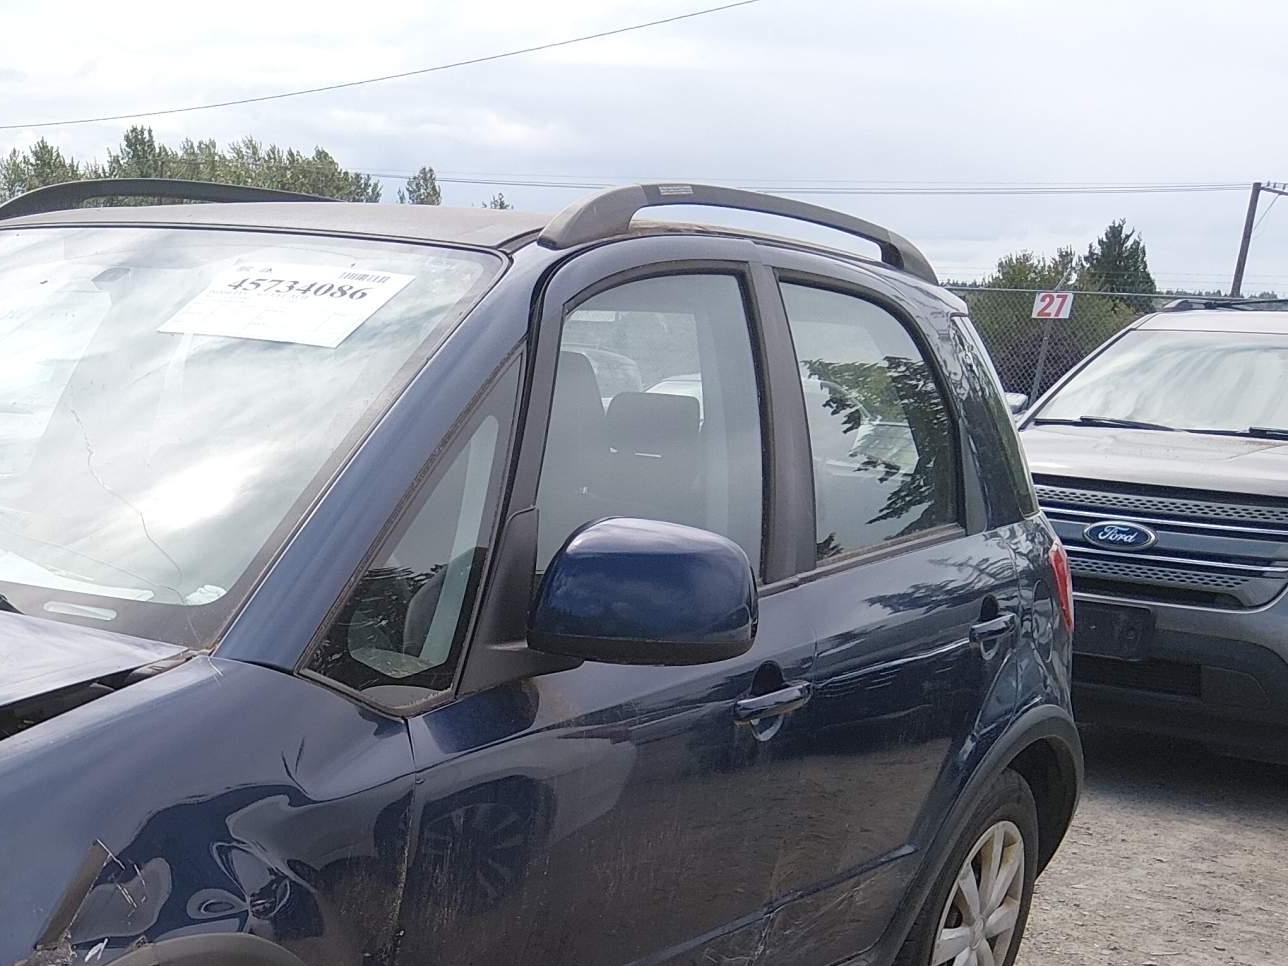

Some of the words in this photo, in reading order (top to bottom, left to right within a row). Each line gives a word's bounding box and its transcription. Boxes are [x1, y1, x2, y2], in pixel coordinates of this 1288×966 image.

[227, 277, 372, 300] 45734086
[1037, 293, 1069, 317] 27
[1098, 525, 1138, 543] Ford
